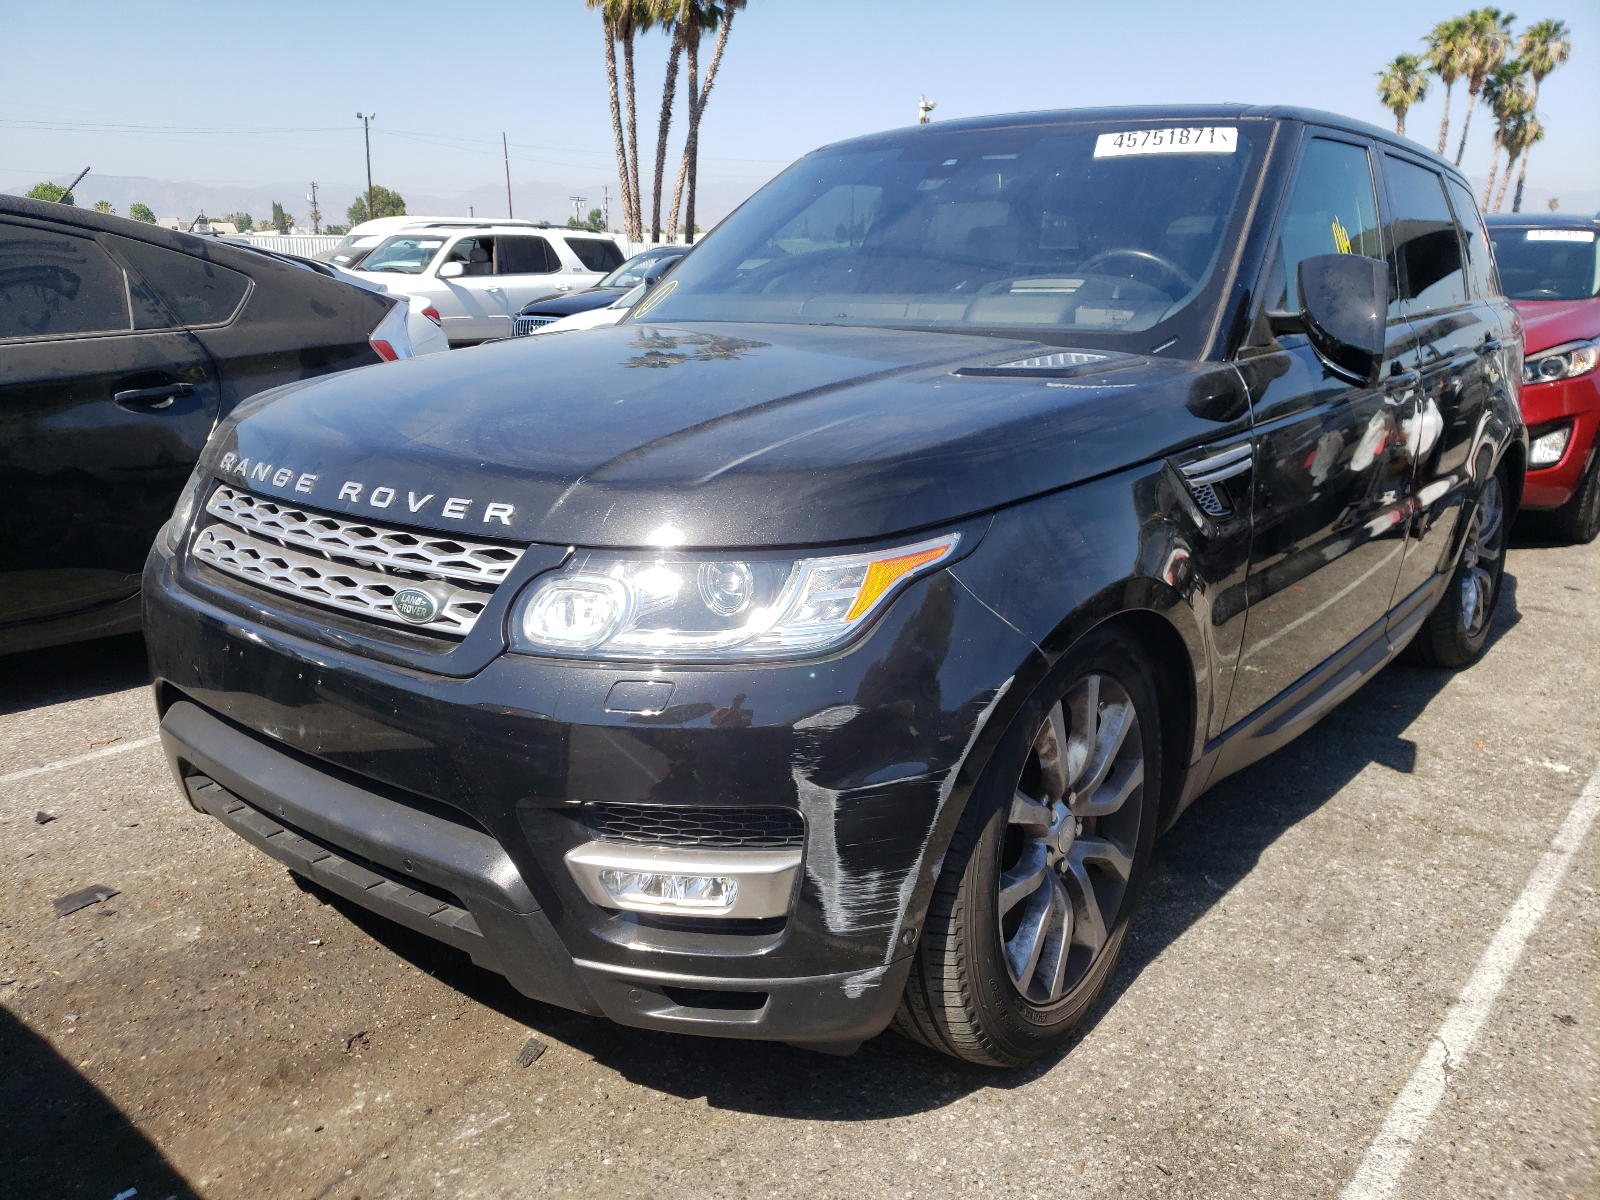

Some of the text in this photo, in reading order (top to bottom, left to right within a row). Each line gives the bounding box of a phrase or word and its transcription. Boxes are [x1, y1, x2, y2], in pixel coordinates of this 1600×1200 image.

[220, 451, 515, 526] RANGE ROVER
[400, 593, 422, 606] LAND
[401, 603, 427, 617] ROVER
